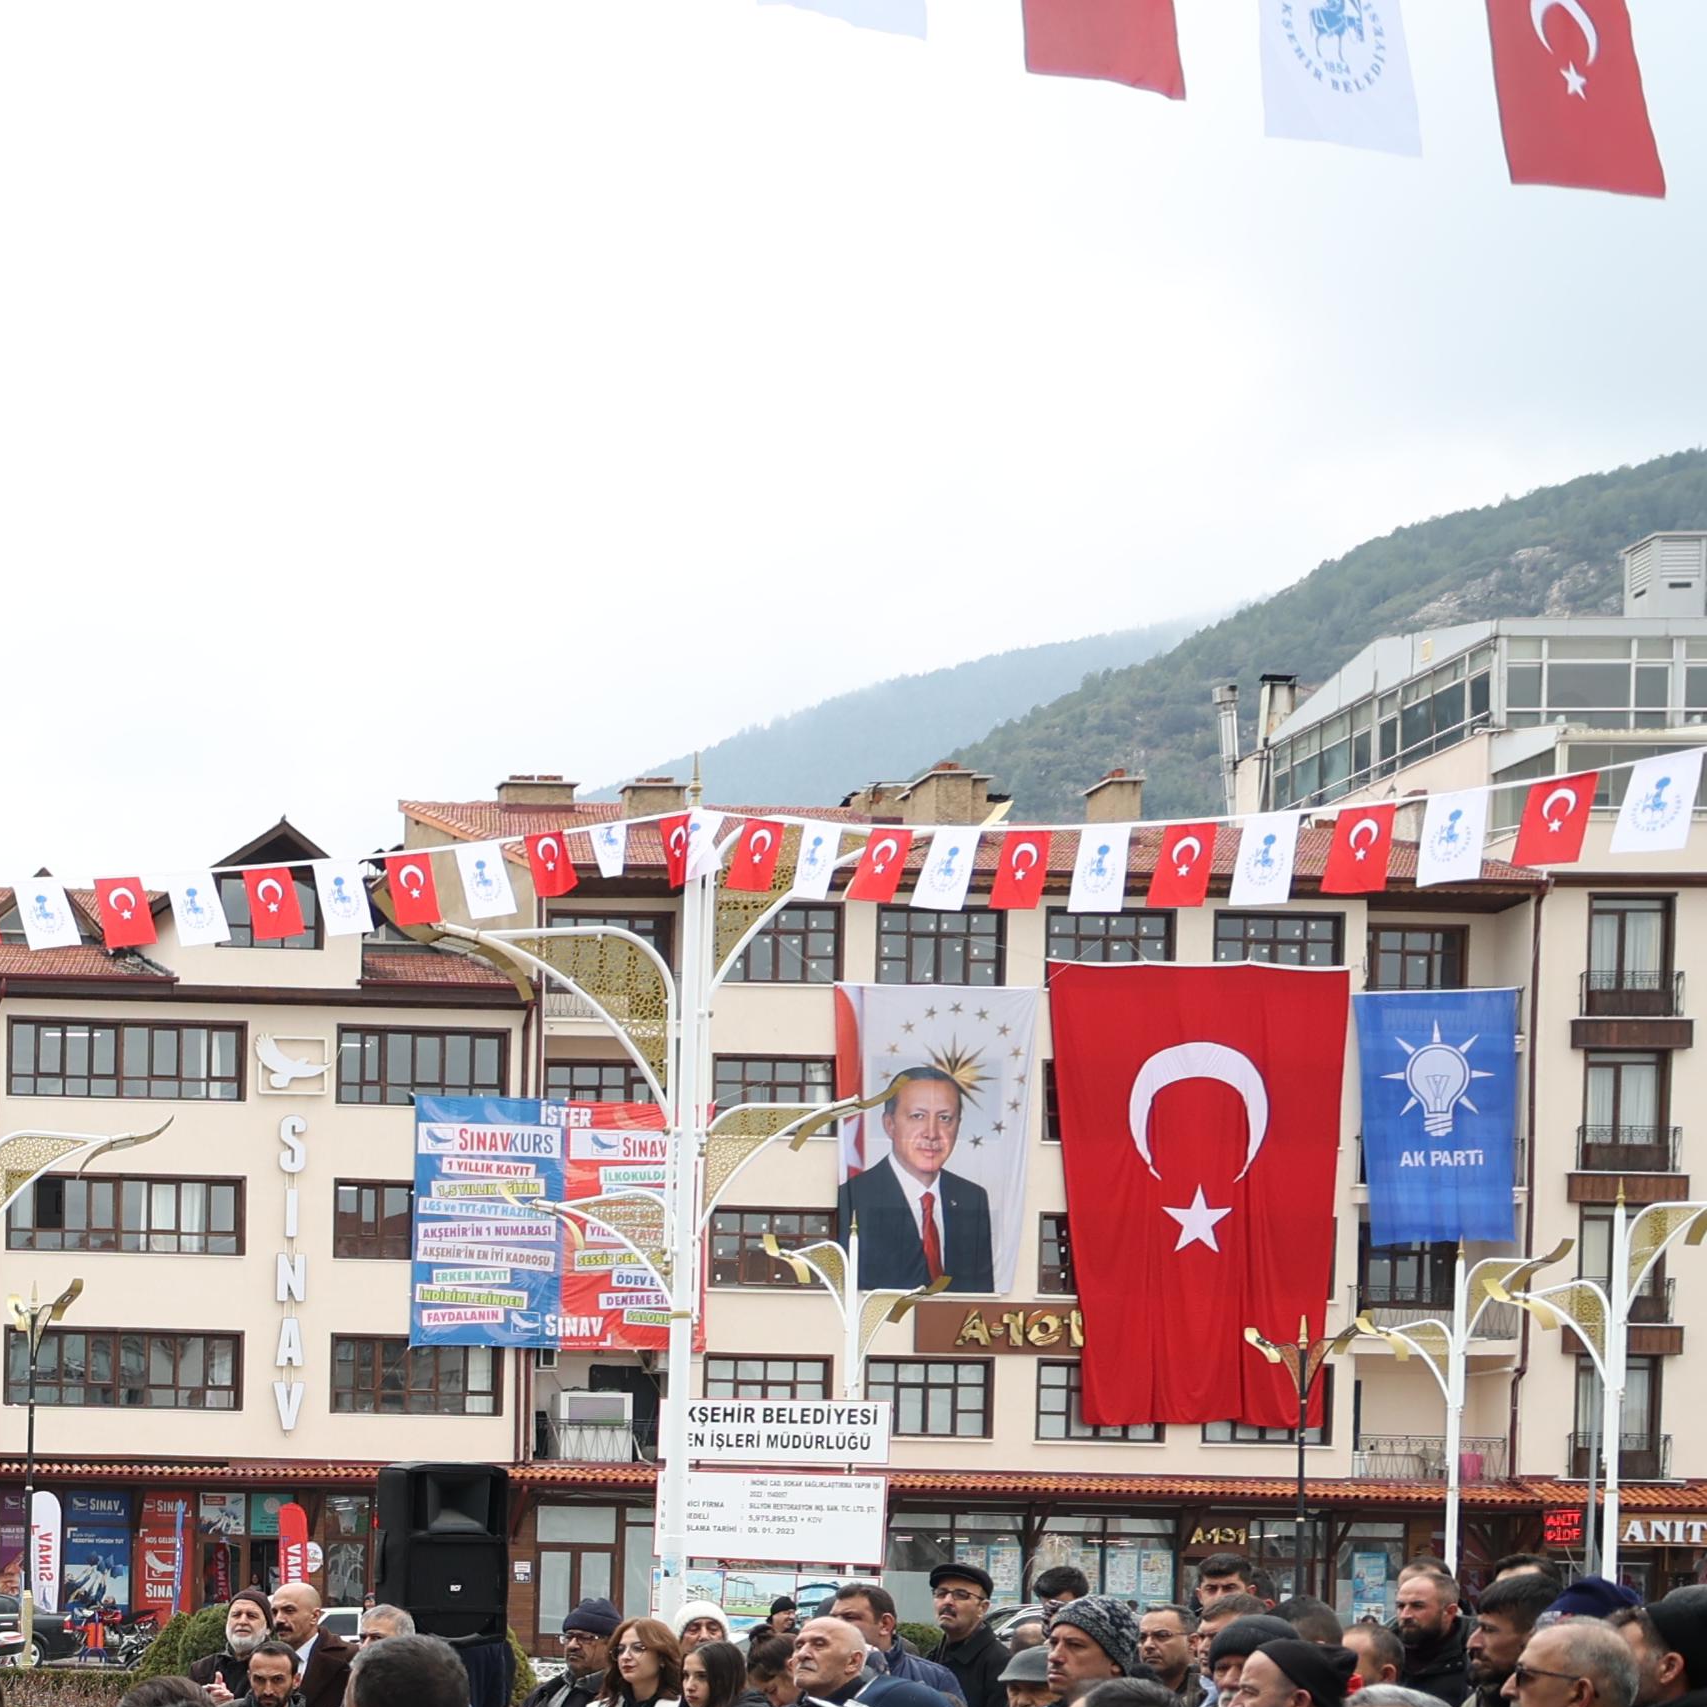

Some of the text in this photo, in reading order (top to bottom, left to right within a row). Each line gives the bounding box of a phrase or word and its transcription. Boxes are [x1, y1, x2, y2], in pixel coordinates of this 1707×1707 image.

[540, 1100, 594, 1127] İSTER
[1399, 1149, 1484, 1167] AK PARTİ
[457, 1161, 493, 1173] YILLIK
[496, 1163, 531, 1177] KAYIT
[495, 1226, 552, 1237] NUMARASI
[505, 1252, 550, 1267] KADROSU
[272, 1113, 308, 1431] SINAV
[435, 1269, 508, 1282] ERKEN KAYIT
[616, 1271, 647, 1285] ÖDEV
[606, 1295, 652, 1306] DENEME
[426, 1310, 499, 1323] FAYDALANIN
[544, 1313, 604, 1337] SINAV
[688, 1403, 879, 1427] KŞEHİR BELEDİYESİ
[688, 1430, 872, 1452] EN İŞLERİ MÜDÜRLÜĞÜ
[89, 1498, 121, 1511] SINAV
[687, 1524, 711, 1533] ŞLAMA
[1621, 1520, 1707, 1543] ANIT
[145, 1583, 174, 1598] SINA
